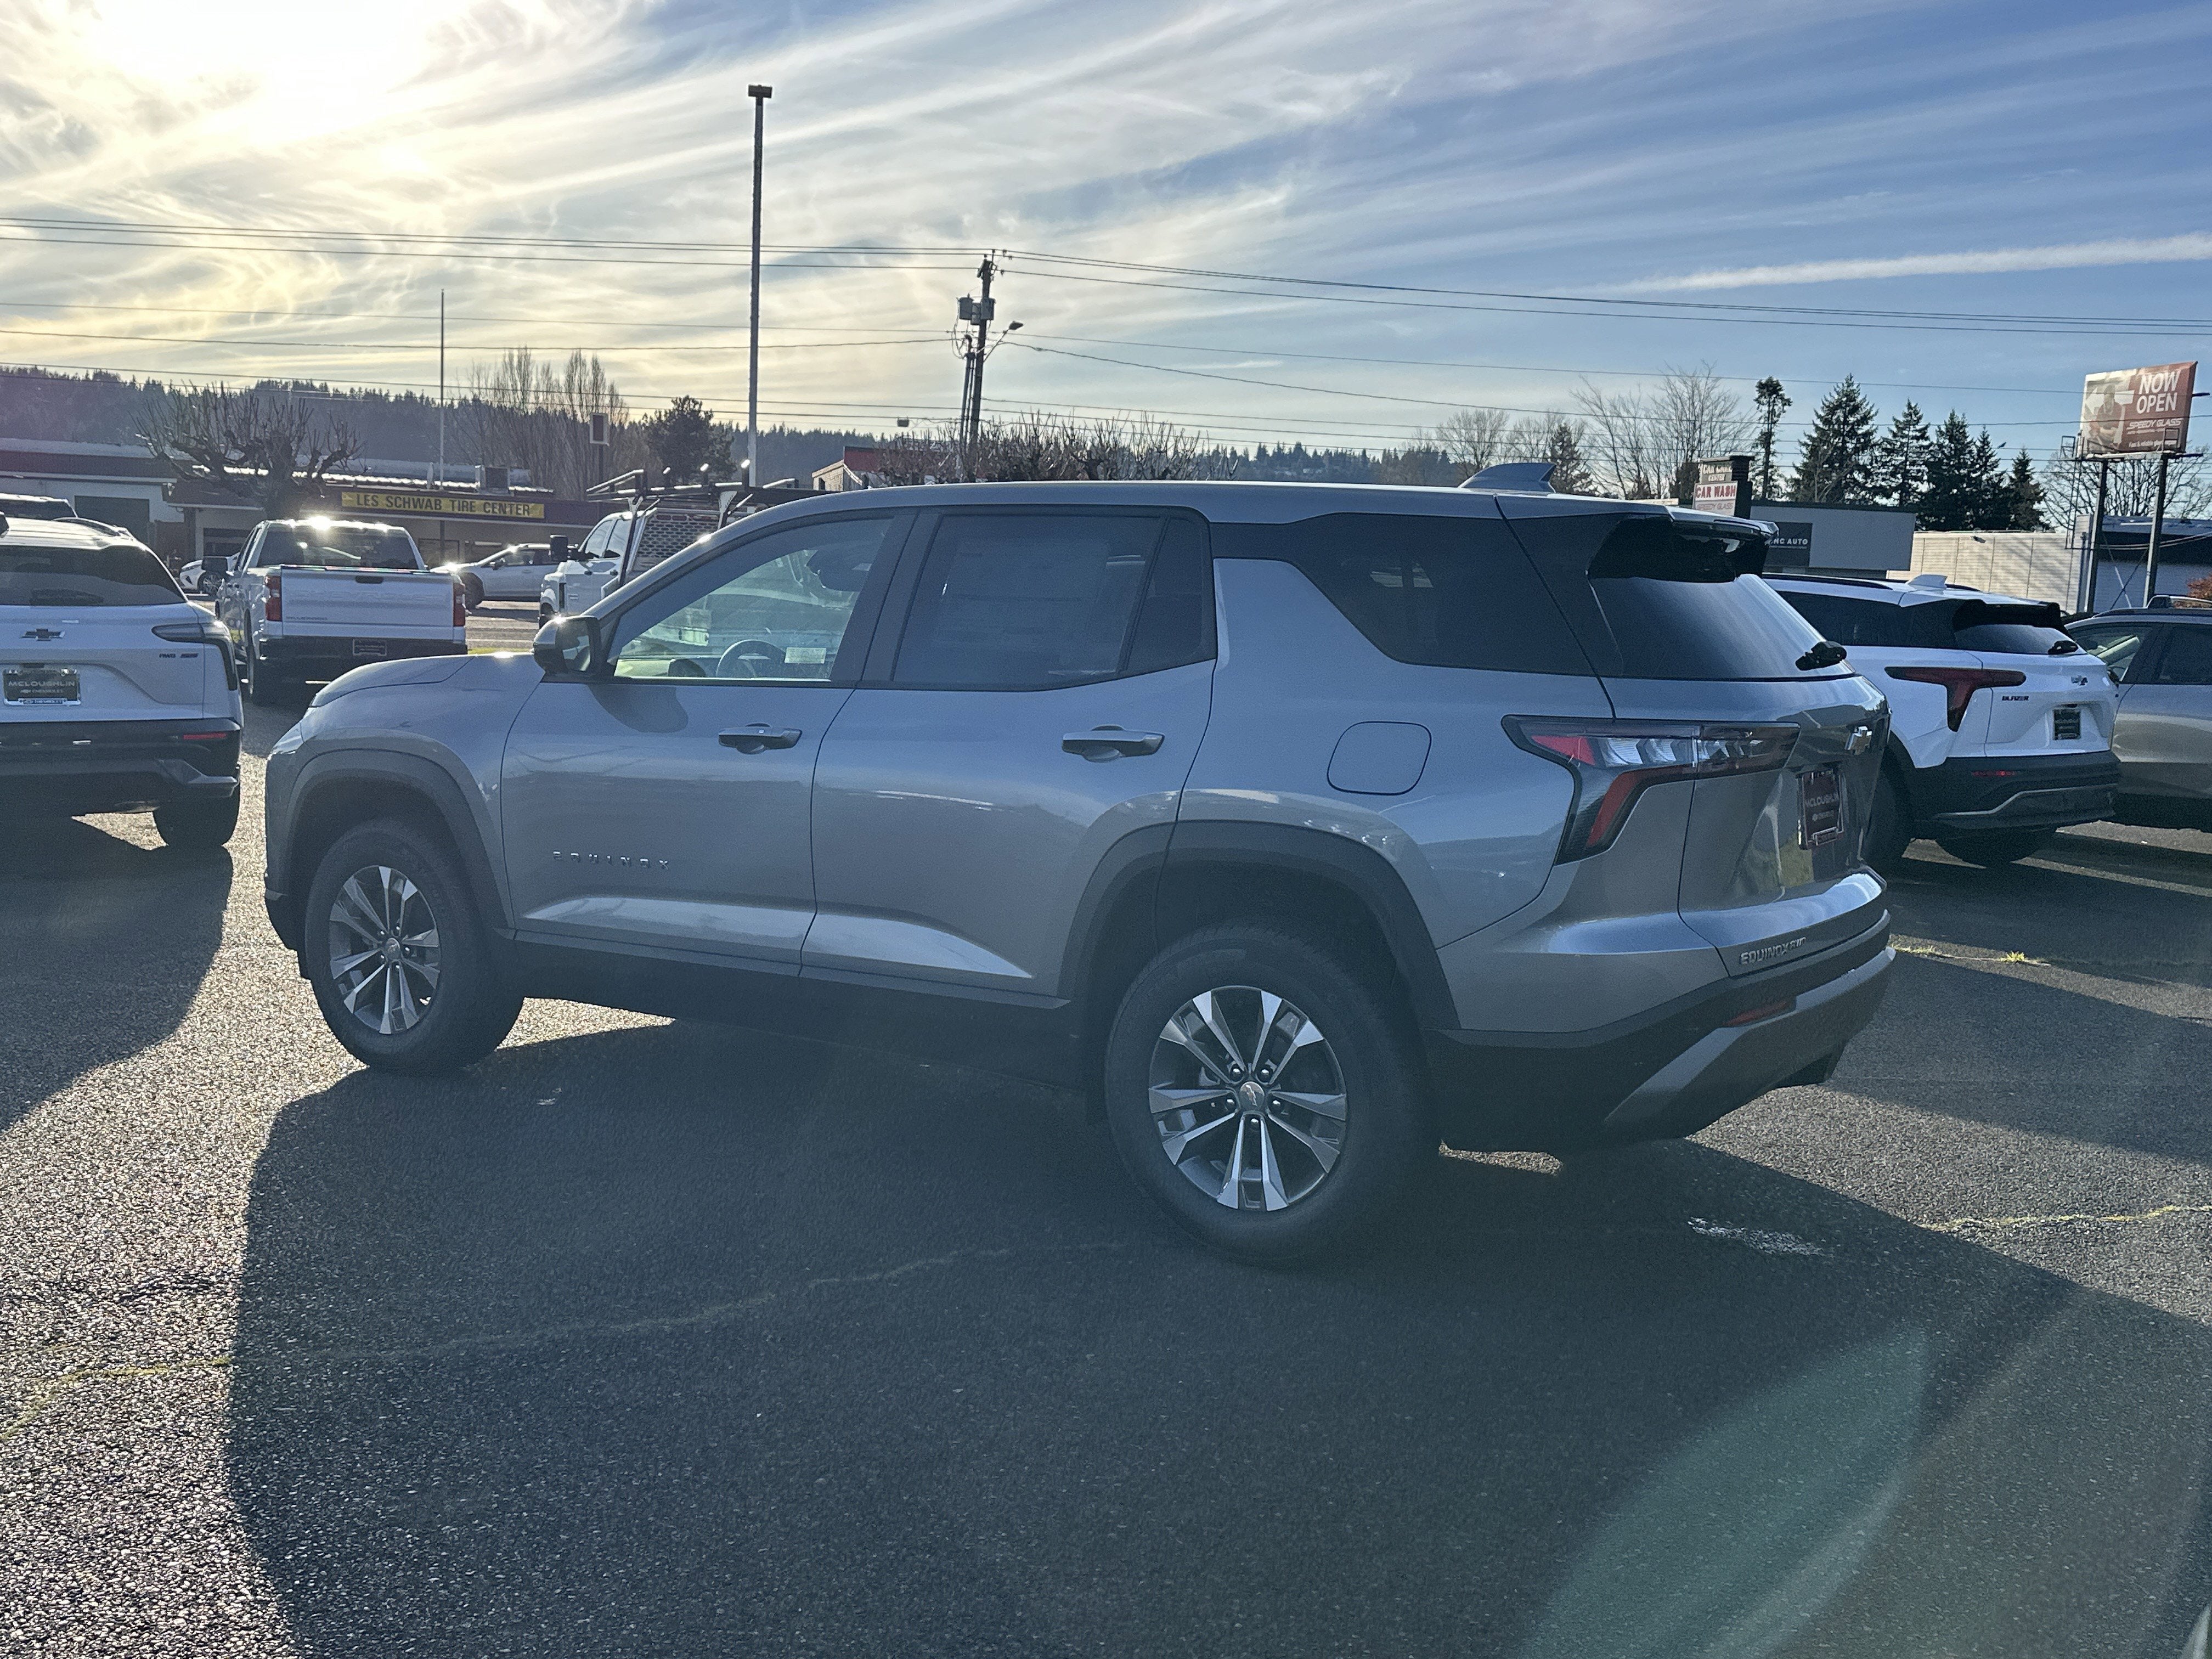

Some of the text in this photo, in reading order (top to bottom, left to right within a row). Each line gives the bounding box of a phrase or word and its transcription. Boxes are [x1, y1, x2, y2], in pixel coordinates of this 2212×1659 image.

[2138, 370, 2180, 394] NOW
[2136, 393, 2177, 414] OPEN
[2126, 417, 2184, 430] SPEEDY GLASS
[1695, 485, 1736, 498] CAR WASH
[357, 494, 531, 515] LES SCHWAB TIRE CENTER
[552, 851, 669, 870] EQUINOX
[1740, 943, 1788, 964] EQUINOX
